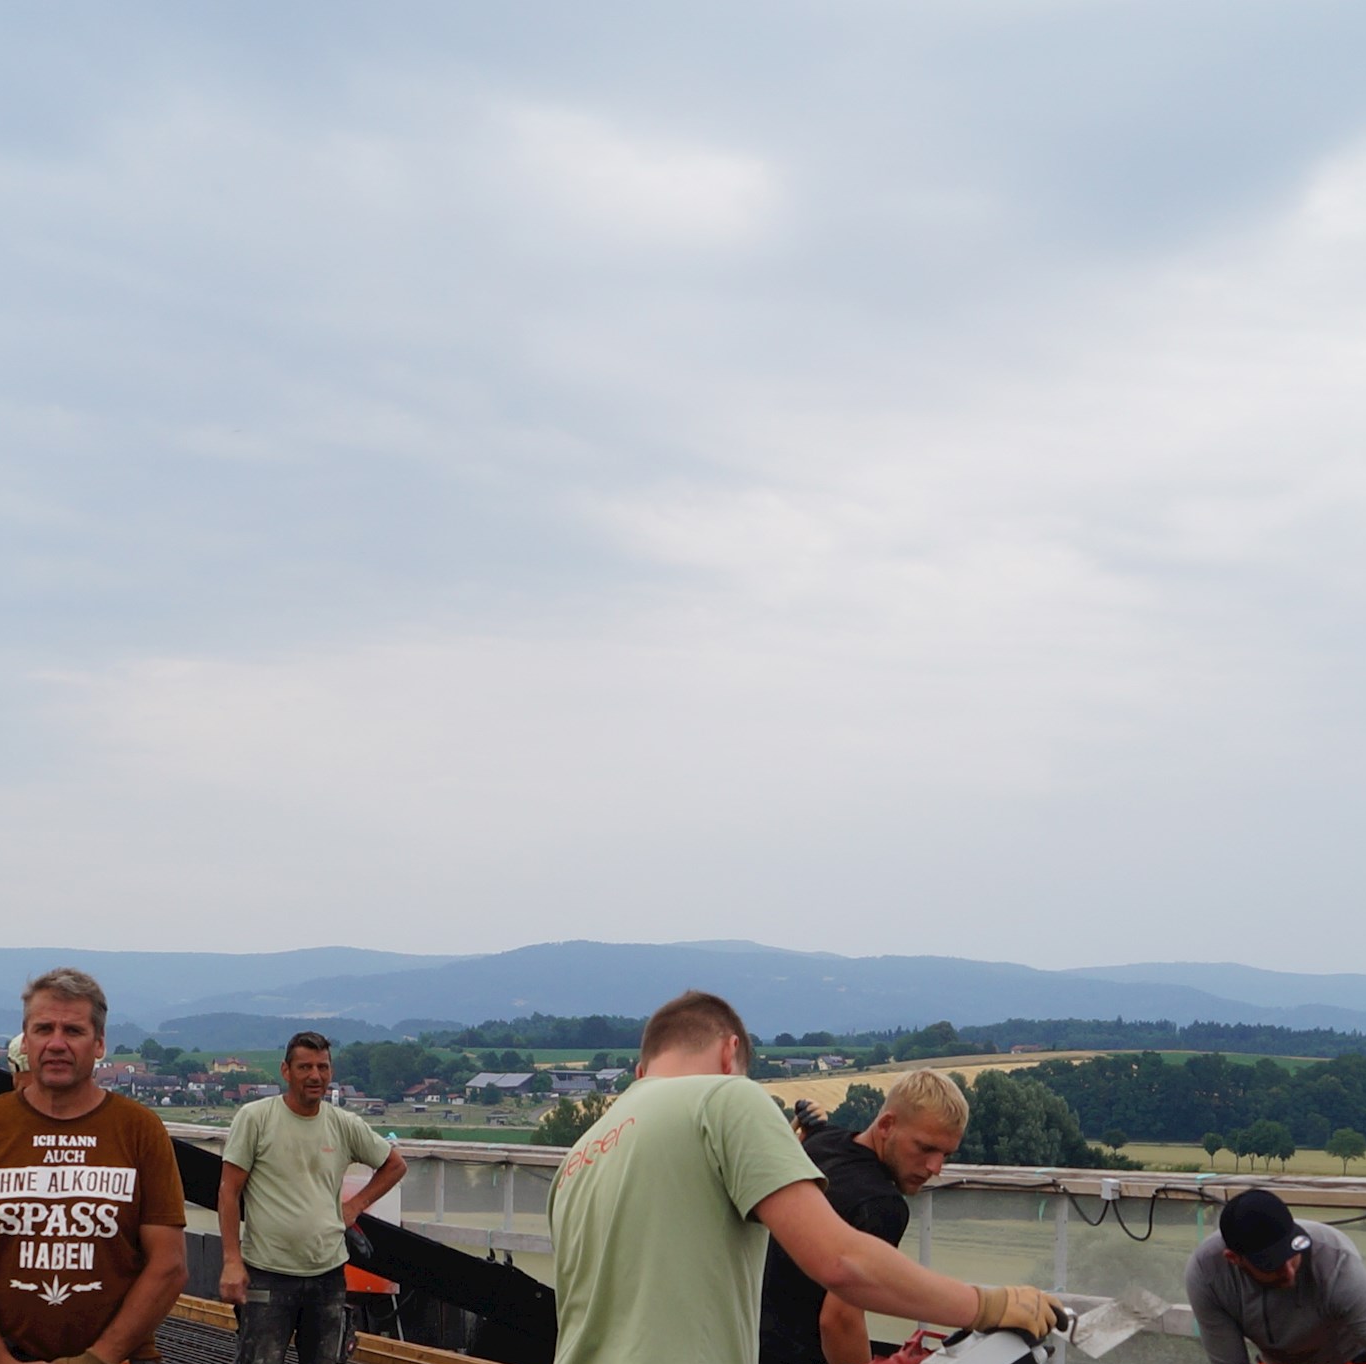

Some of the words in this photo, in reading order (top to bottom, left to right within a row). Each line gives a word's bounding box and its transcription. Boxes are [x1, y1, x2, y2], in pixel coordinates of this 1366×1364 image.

[33, 1135, 56, 1147] ICH
[58, 1135, 97, 1147] KANN
[43, 1150, 86, 1163] AUCH
[47, 1170, 132, 1196] ALKOHOL
[19, 1241, 95, 1270] HABEN
